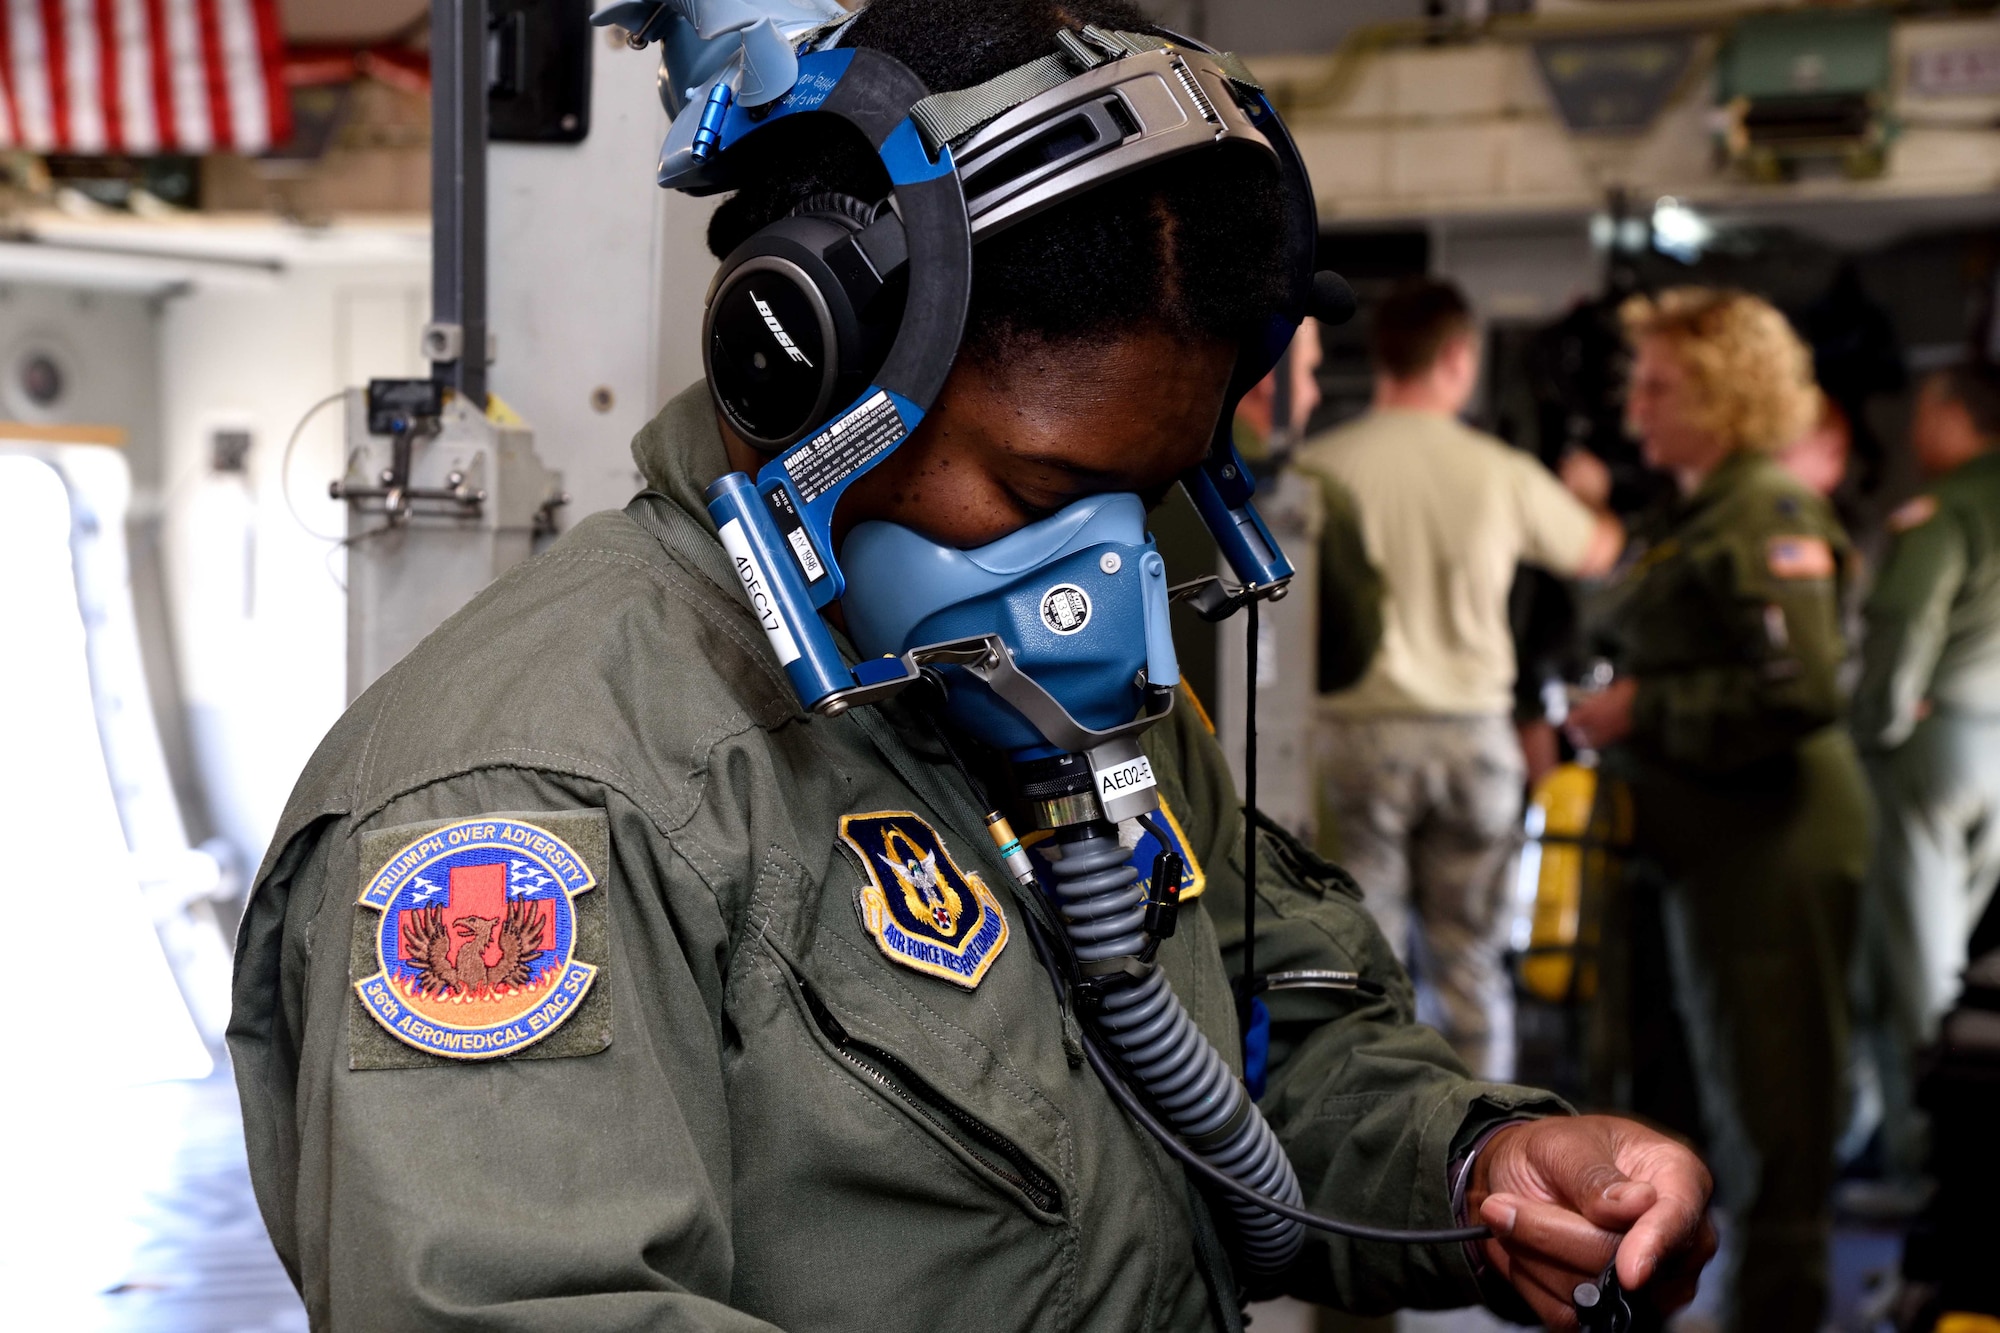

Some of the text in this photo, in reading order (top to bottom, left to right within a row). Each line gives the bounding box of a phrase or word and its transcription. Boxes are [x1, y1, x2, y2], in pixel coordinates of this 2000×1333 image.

[750, 290, 813, 368] BOSE
[783, 445, 812, 470] MODEL
[811, 430, 833, 450] 358-
[788, 399, 891, 476] MASK ASSY-CREW PRESS DEMAND OXYGEN
[801, 486, 813, 496] WEAR
[813, 478, 824, 488] OVER
[824, 466, 840, 480] BEARDS
[846, 452, 859, 464] HEAVY
[859, 443, 873, 454] FACIAL
[874, 435, 884, 444] HAIR
[884, 422, 902, 437] GROWTH
[809, 472, 820, 481] MASK
[842, 447, 854, 457] BEEN
[856, 440, 865, 448] TSO
[866, 424, 887, 440] QUALIFIED
[888, 416, 898, 424] FOR
[819, 468, 850, 492] AVIATION
[853, 438, 892, 468] LANCASTER,
[892, 430, 904, 440] N.Y.
[770, 492, 781, 507] MFG
[777, 488, 793, 514] DATE OF
[792, 465, 813, 482] TSO-C78
[788, 528, 818, 571] MAY 1998
[735, 556, 779, 630] 4DEC17
[1055, 594, 1073, 626] 3339
[372, 824, 583, 898] TRIUMPH OVER ADVERSITY
[884, 906, 1001, 977] AIR FORCE RESERVE COMMAND
[366, 969, 590, 1050] 36th AEROMEDICAL EVAC SQ
